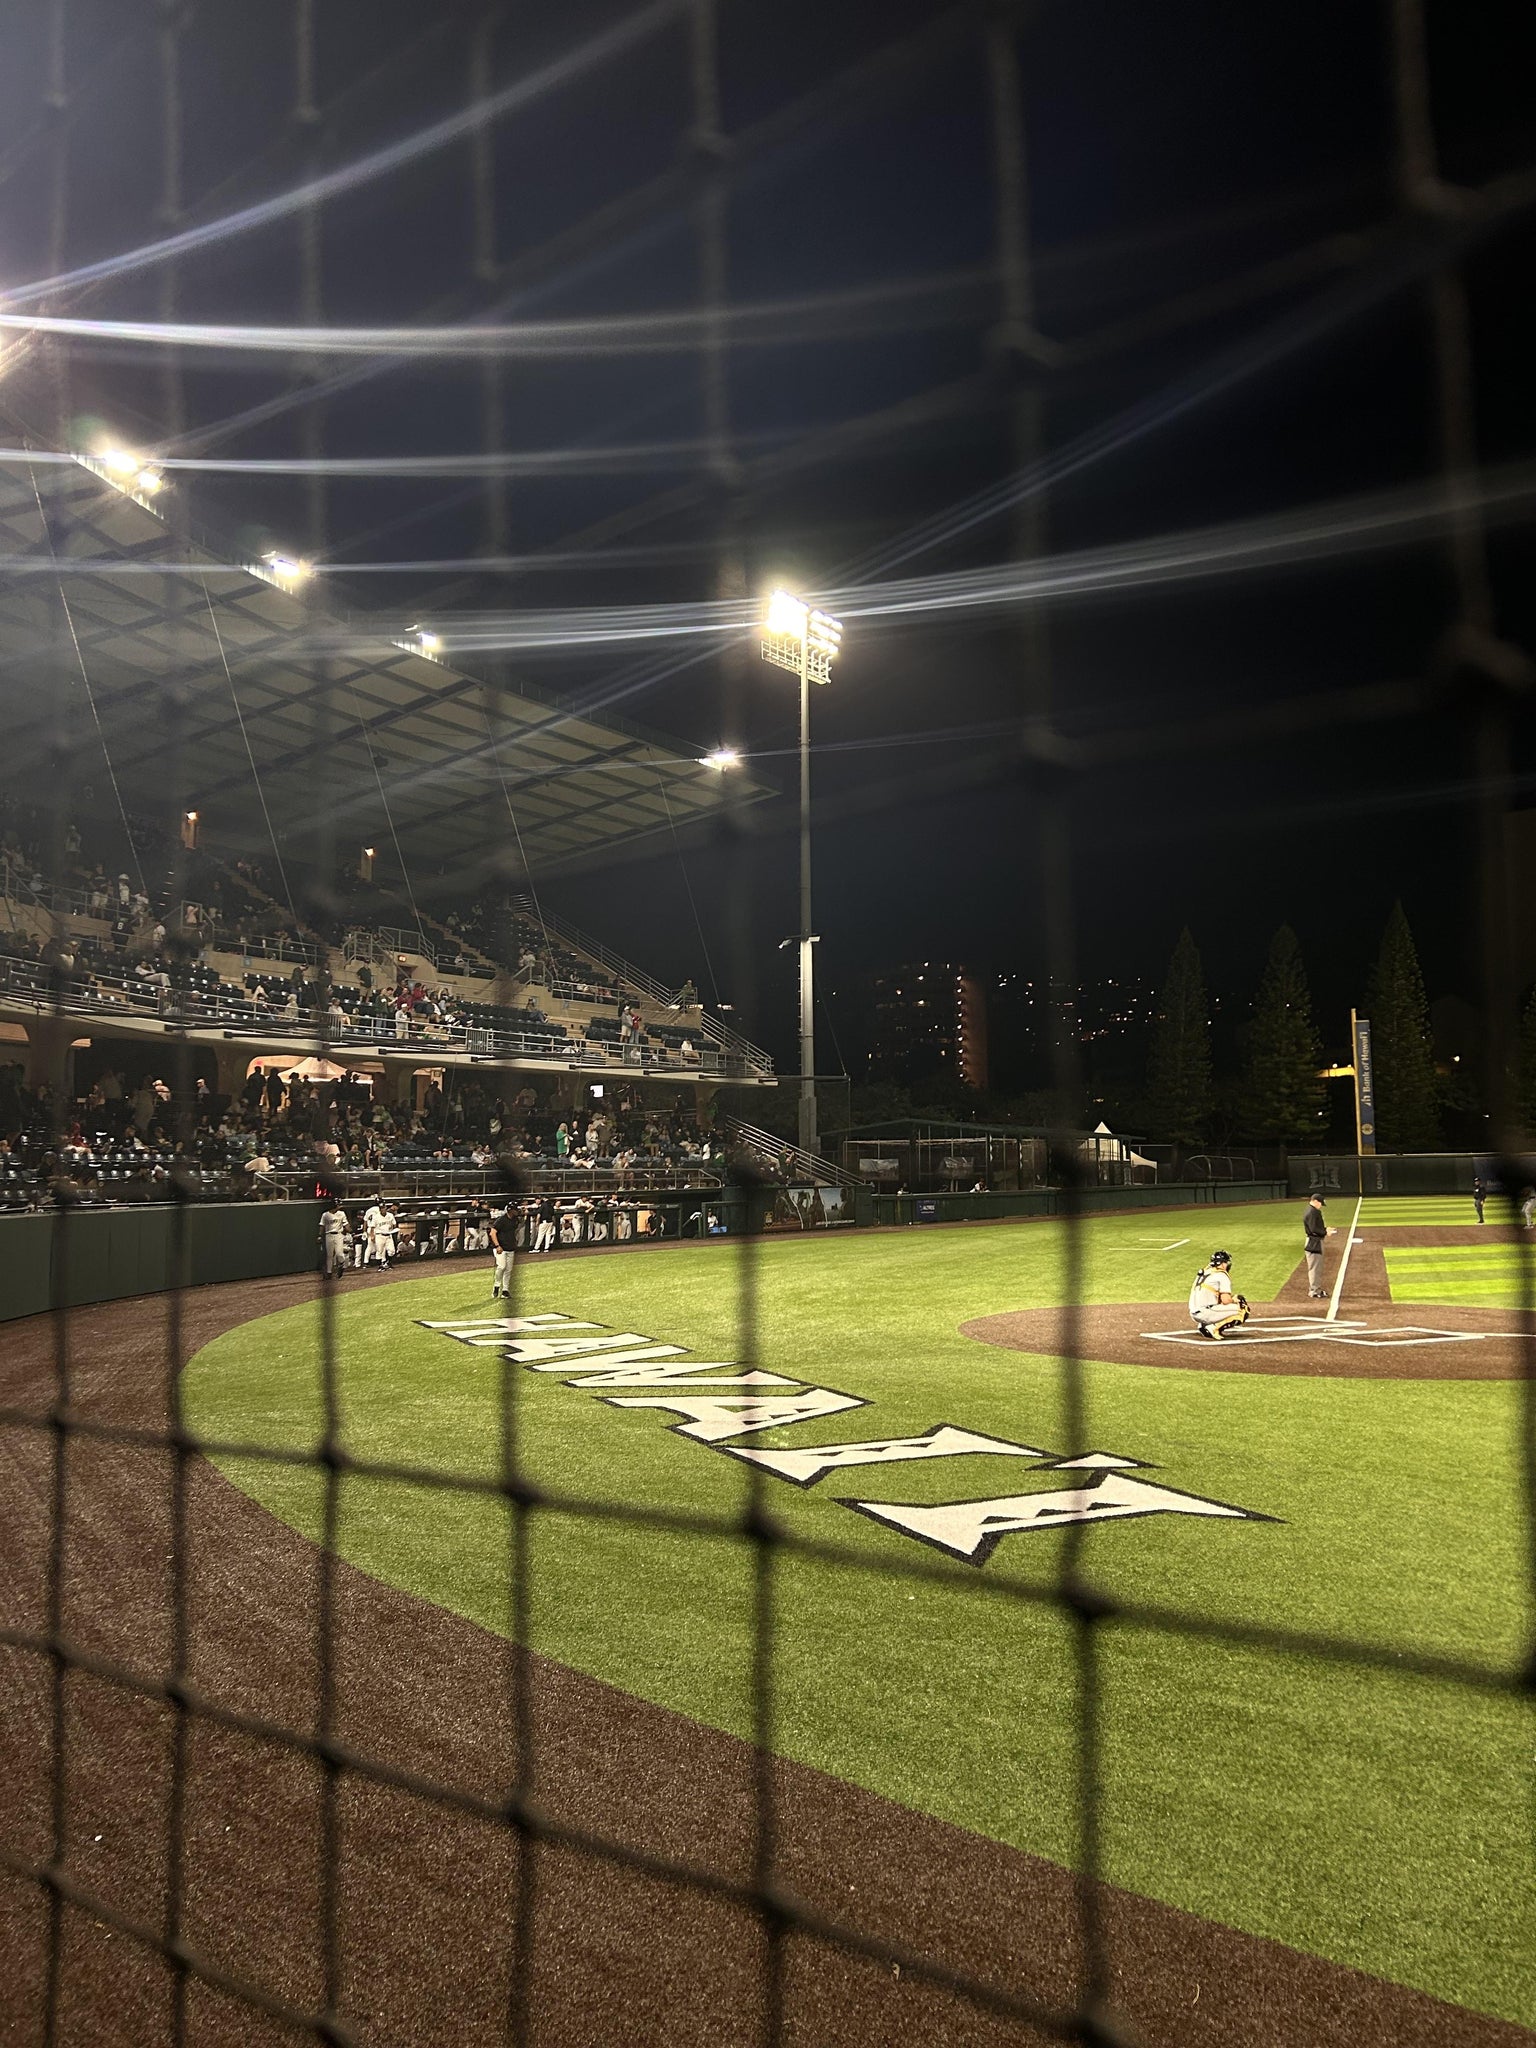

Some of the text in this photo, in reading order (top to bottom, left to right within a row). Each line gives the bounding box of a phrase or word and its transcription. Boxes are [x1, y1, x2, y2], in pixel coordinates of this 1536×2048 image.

[117, 922, 124, 930] 8
[1361, 1061, 1370, 1071] of
[1362, 1071, 1371, 1092] Bank
